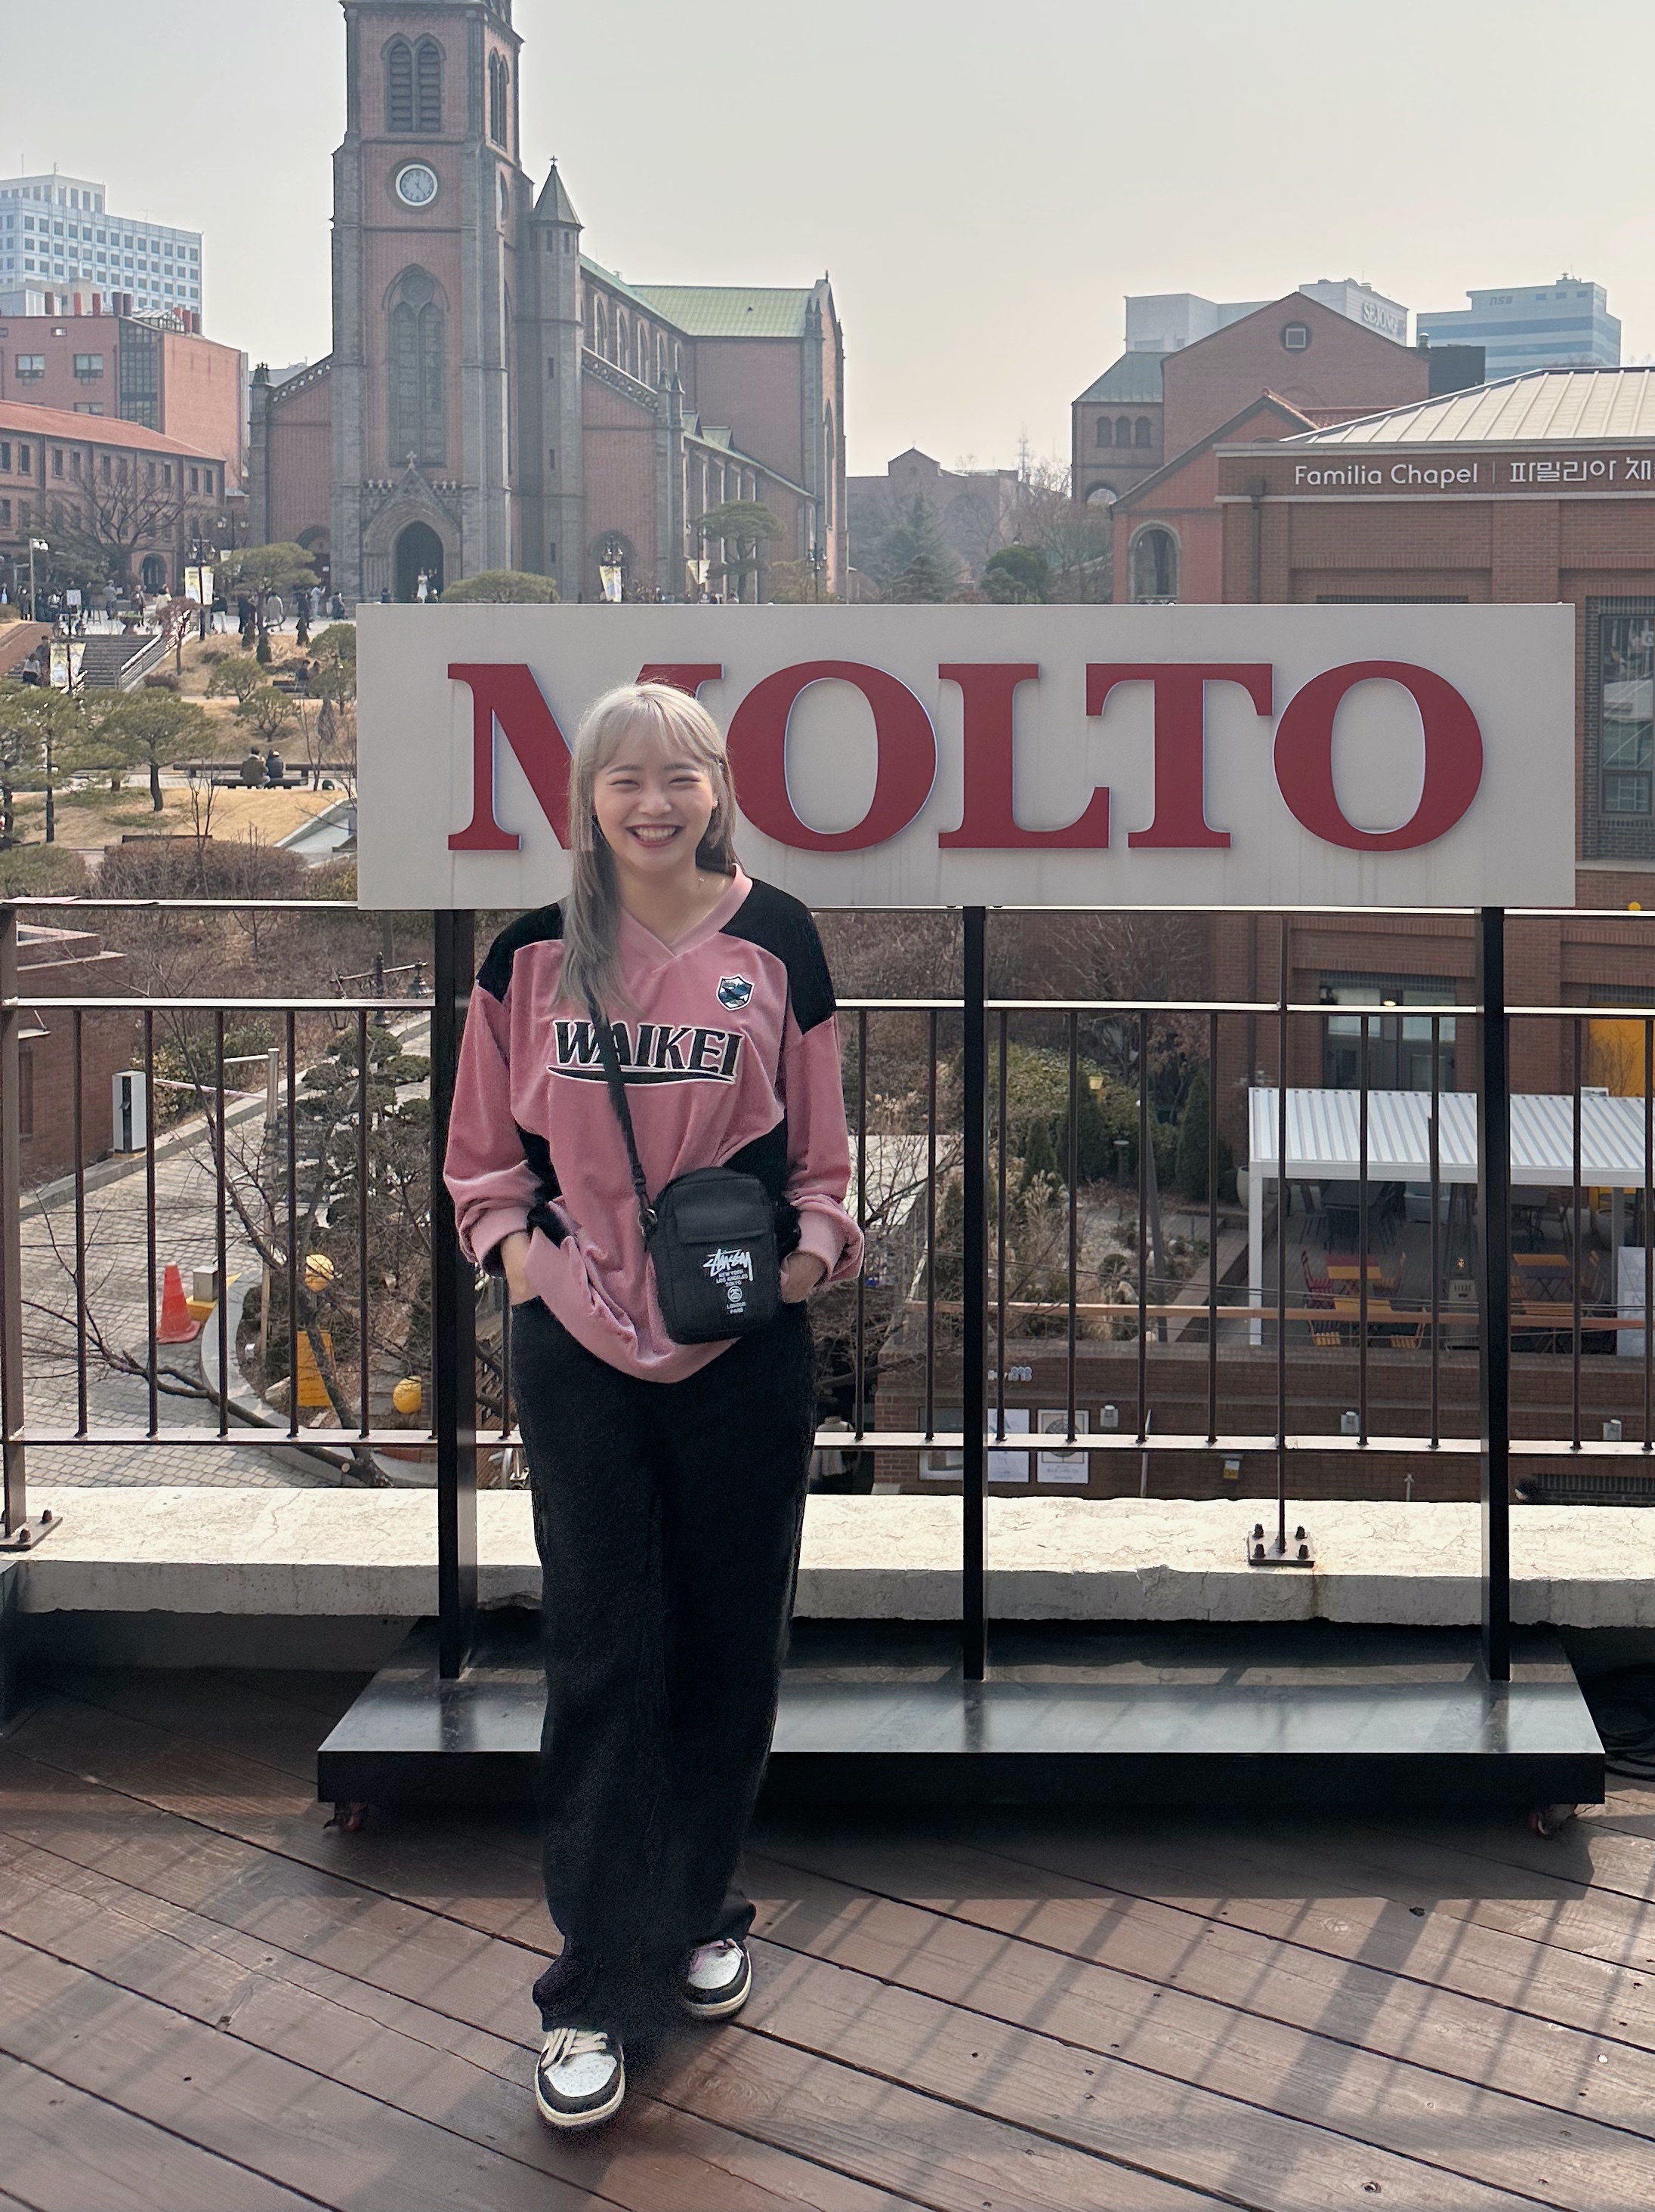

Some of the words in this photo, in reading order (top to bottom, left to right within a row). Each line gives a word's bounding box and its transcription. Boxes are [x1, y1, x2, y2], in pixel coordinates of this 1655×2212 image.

[1363, 301, 1397, 332] SEJONG
[1295, 465, 1382, 485] Familia
[1391, 463, 1477, 489] Chapel
[1509, 460, 1616, 483] 파밀리아
[1624, 456, 1655, 481] 채
